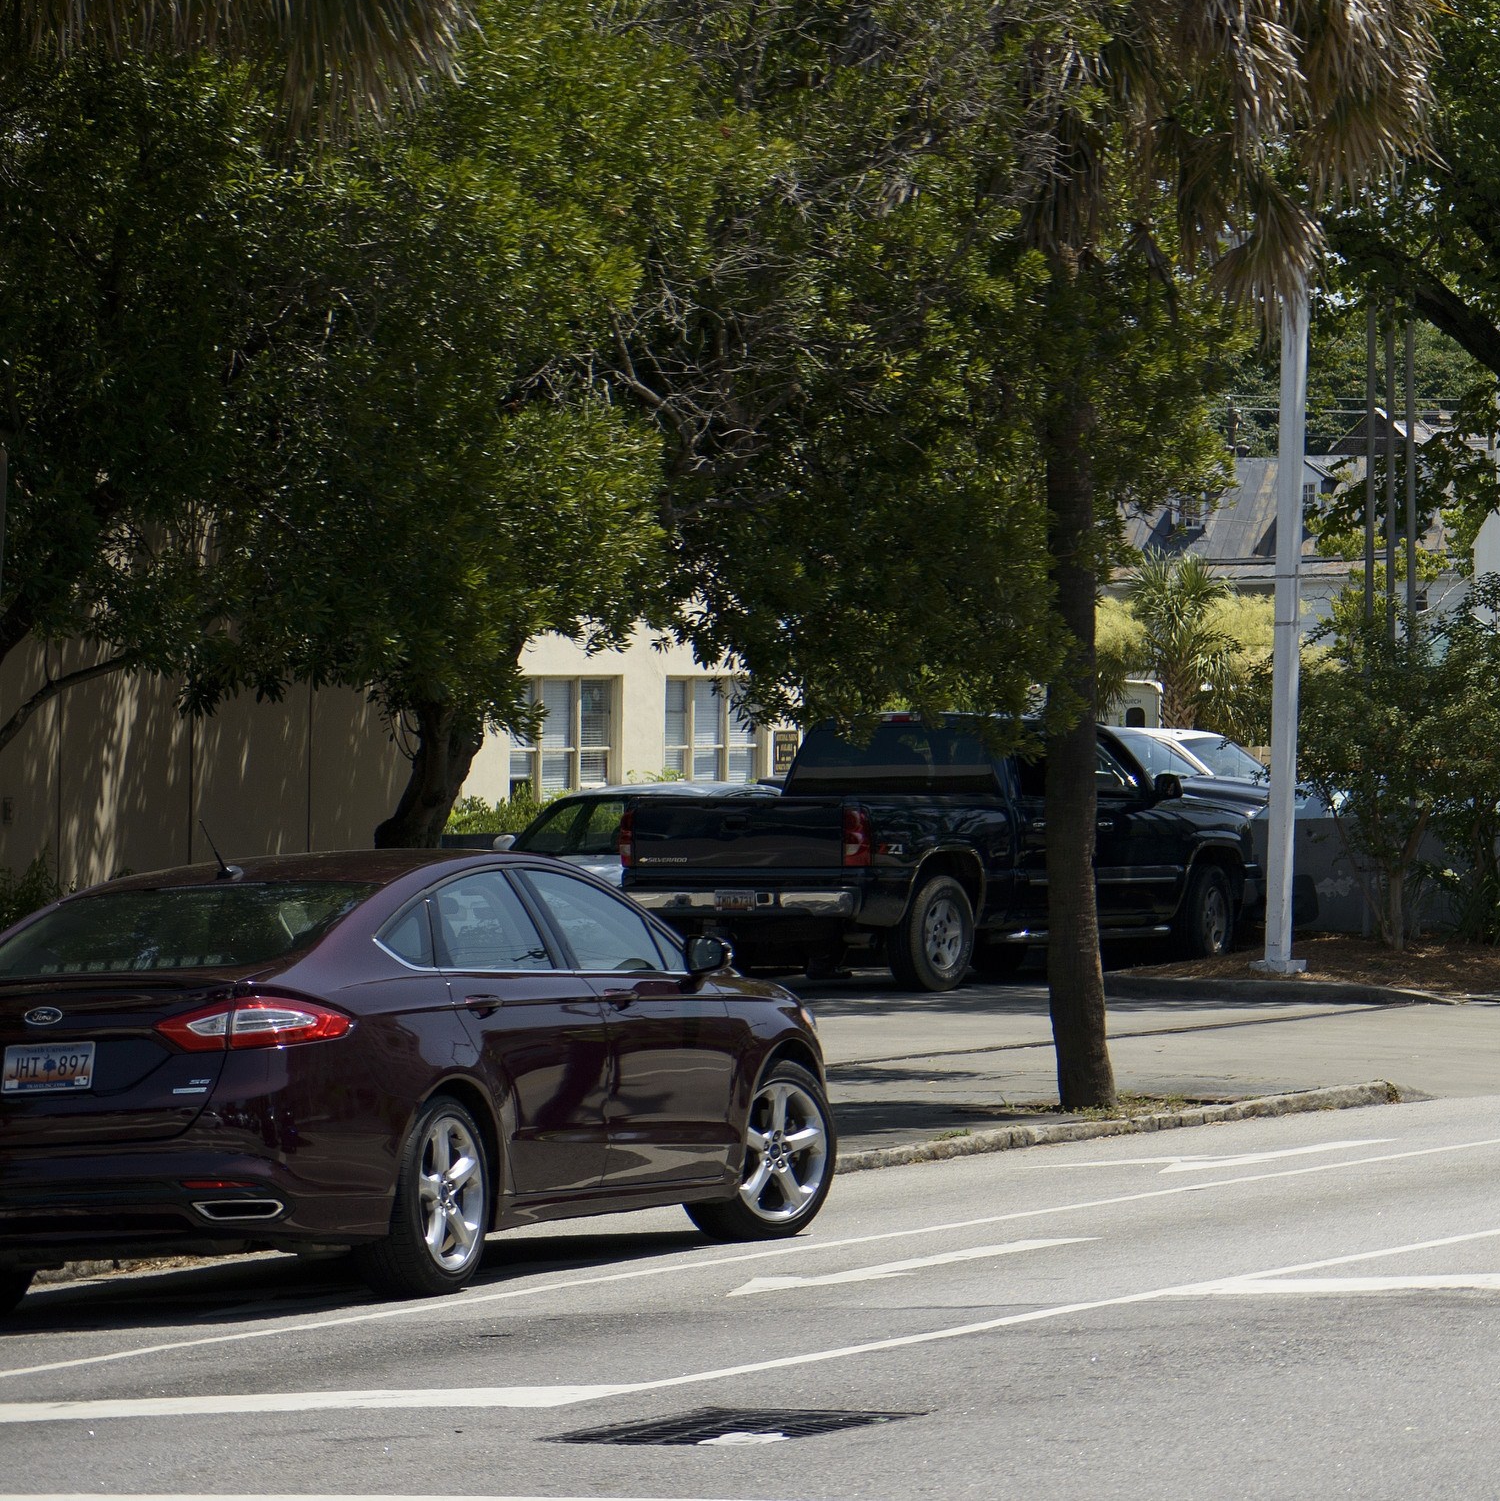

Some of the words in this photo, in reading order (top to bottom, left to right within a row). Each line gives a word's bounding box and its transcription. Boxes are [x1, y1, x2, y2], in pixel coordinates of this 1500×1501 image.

[32, 1011, 53, 1022] Ford
[9, 1057, 40, 1079] JHI
[57, 1054, 89, 1076] 897
